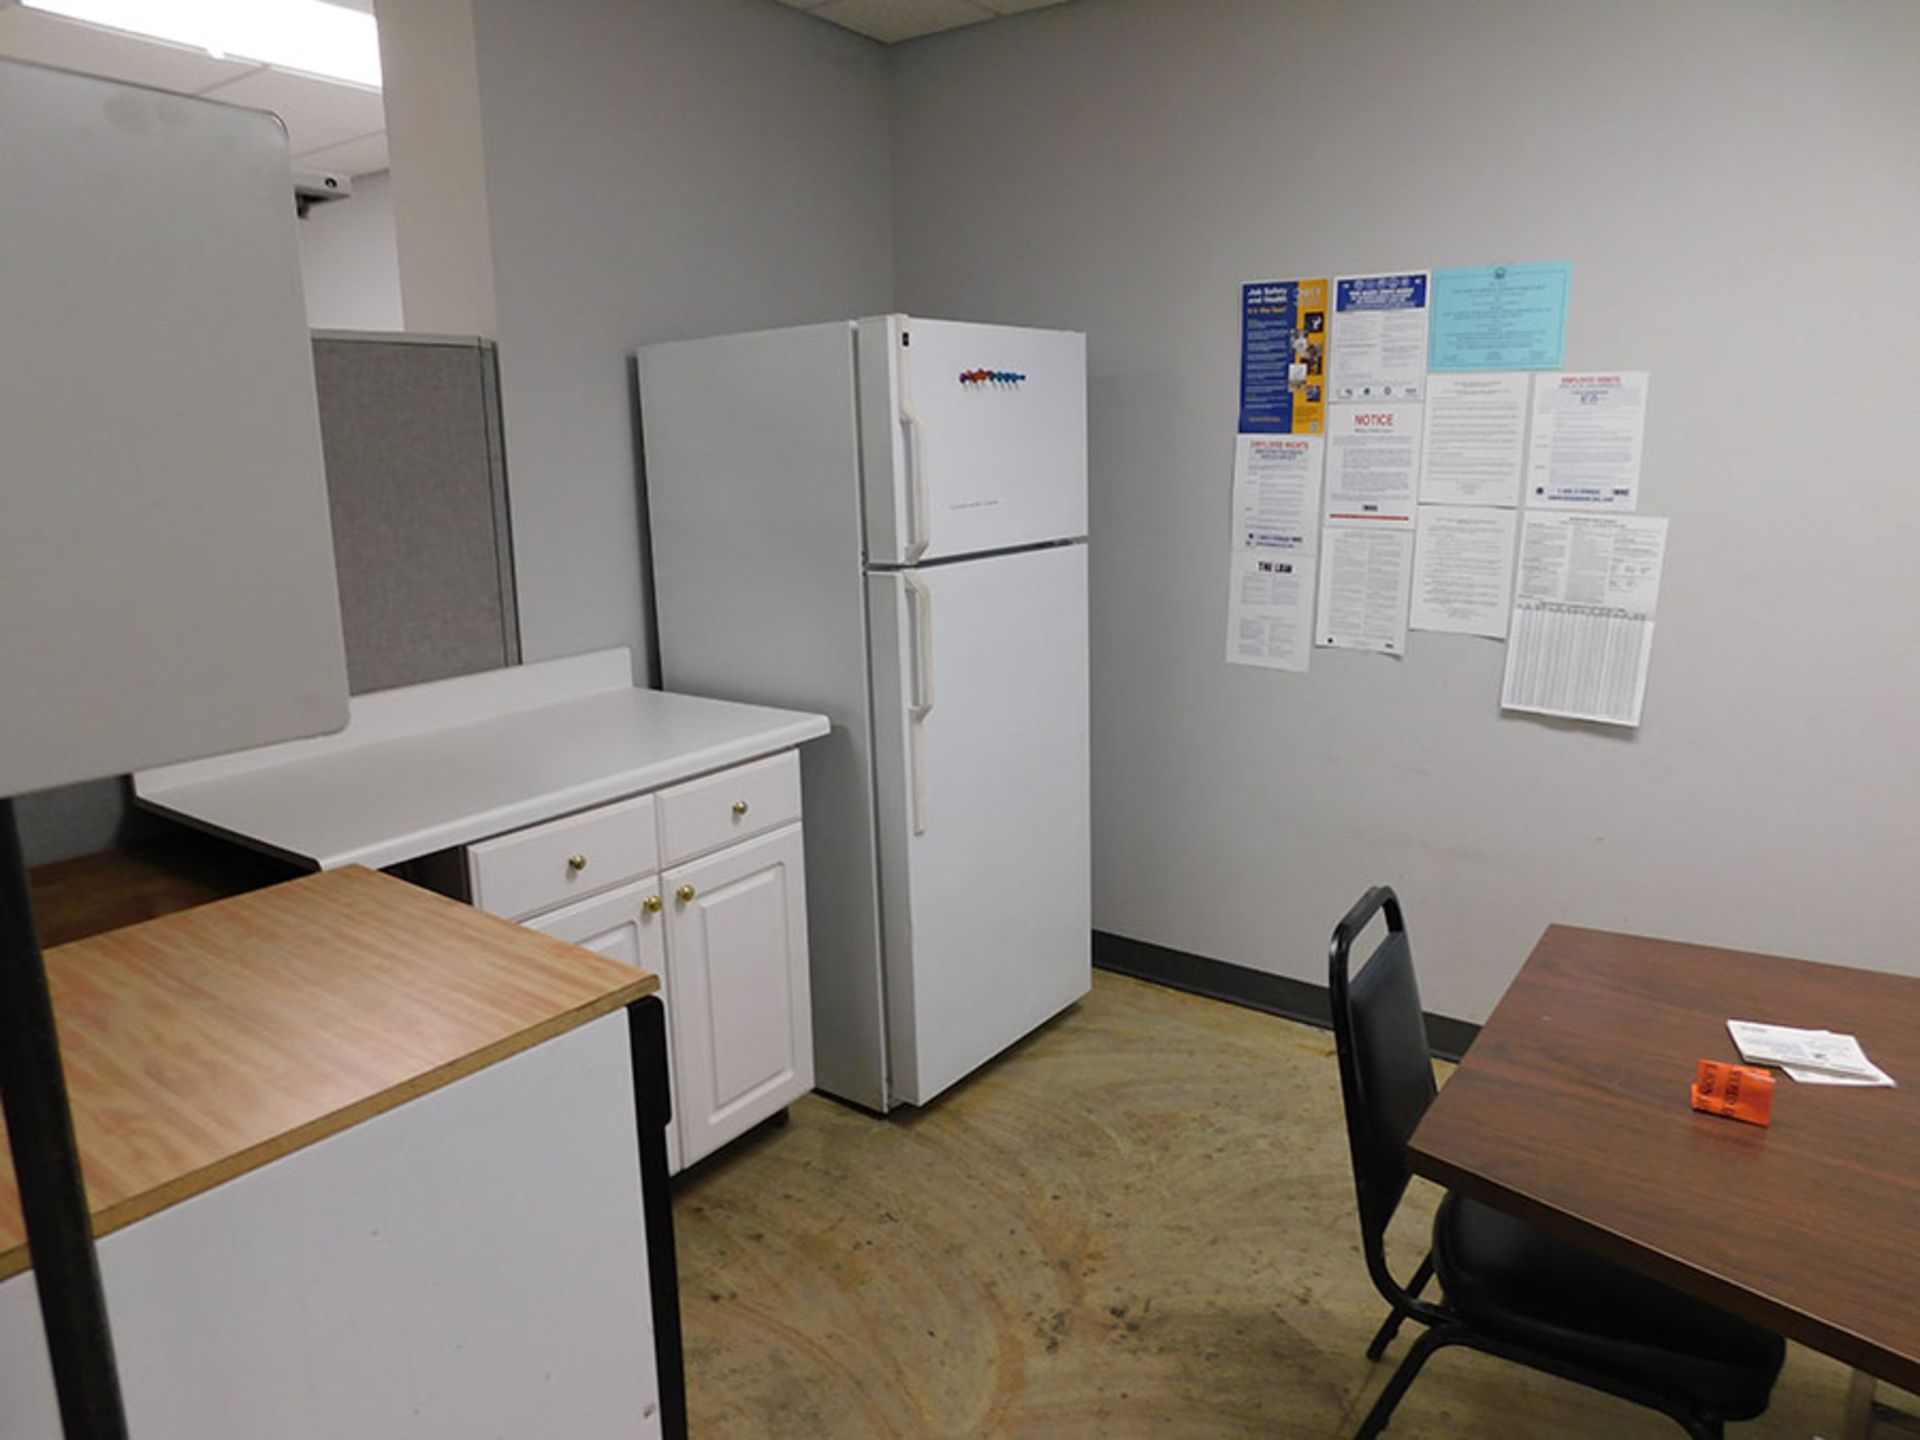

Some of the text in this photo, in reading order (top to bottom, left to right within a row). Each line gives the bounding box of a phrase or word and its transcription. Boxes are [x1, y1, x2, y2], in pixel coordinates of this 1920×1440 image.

[1247, 288, 1261, 296] Job
[1354, 413, 1394, 427] NOTICE
[1258, 561, 1272, 573] THE
